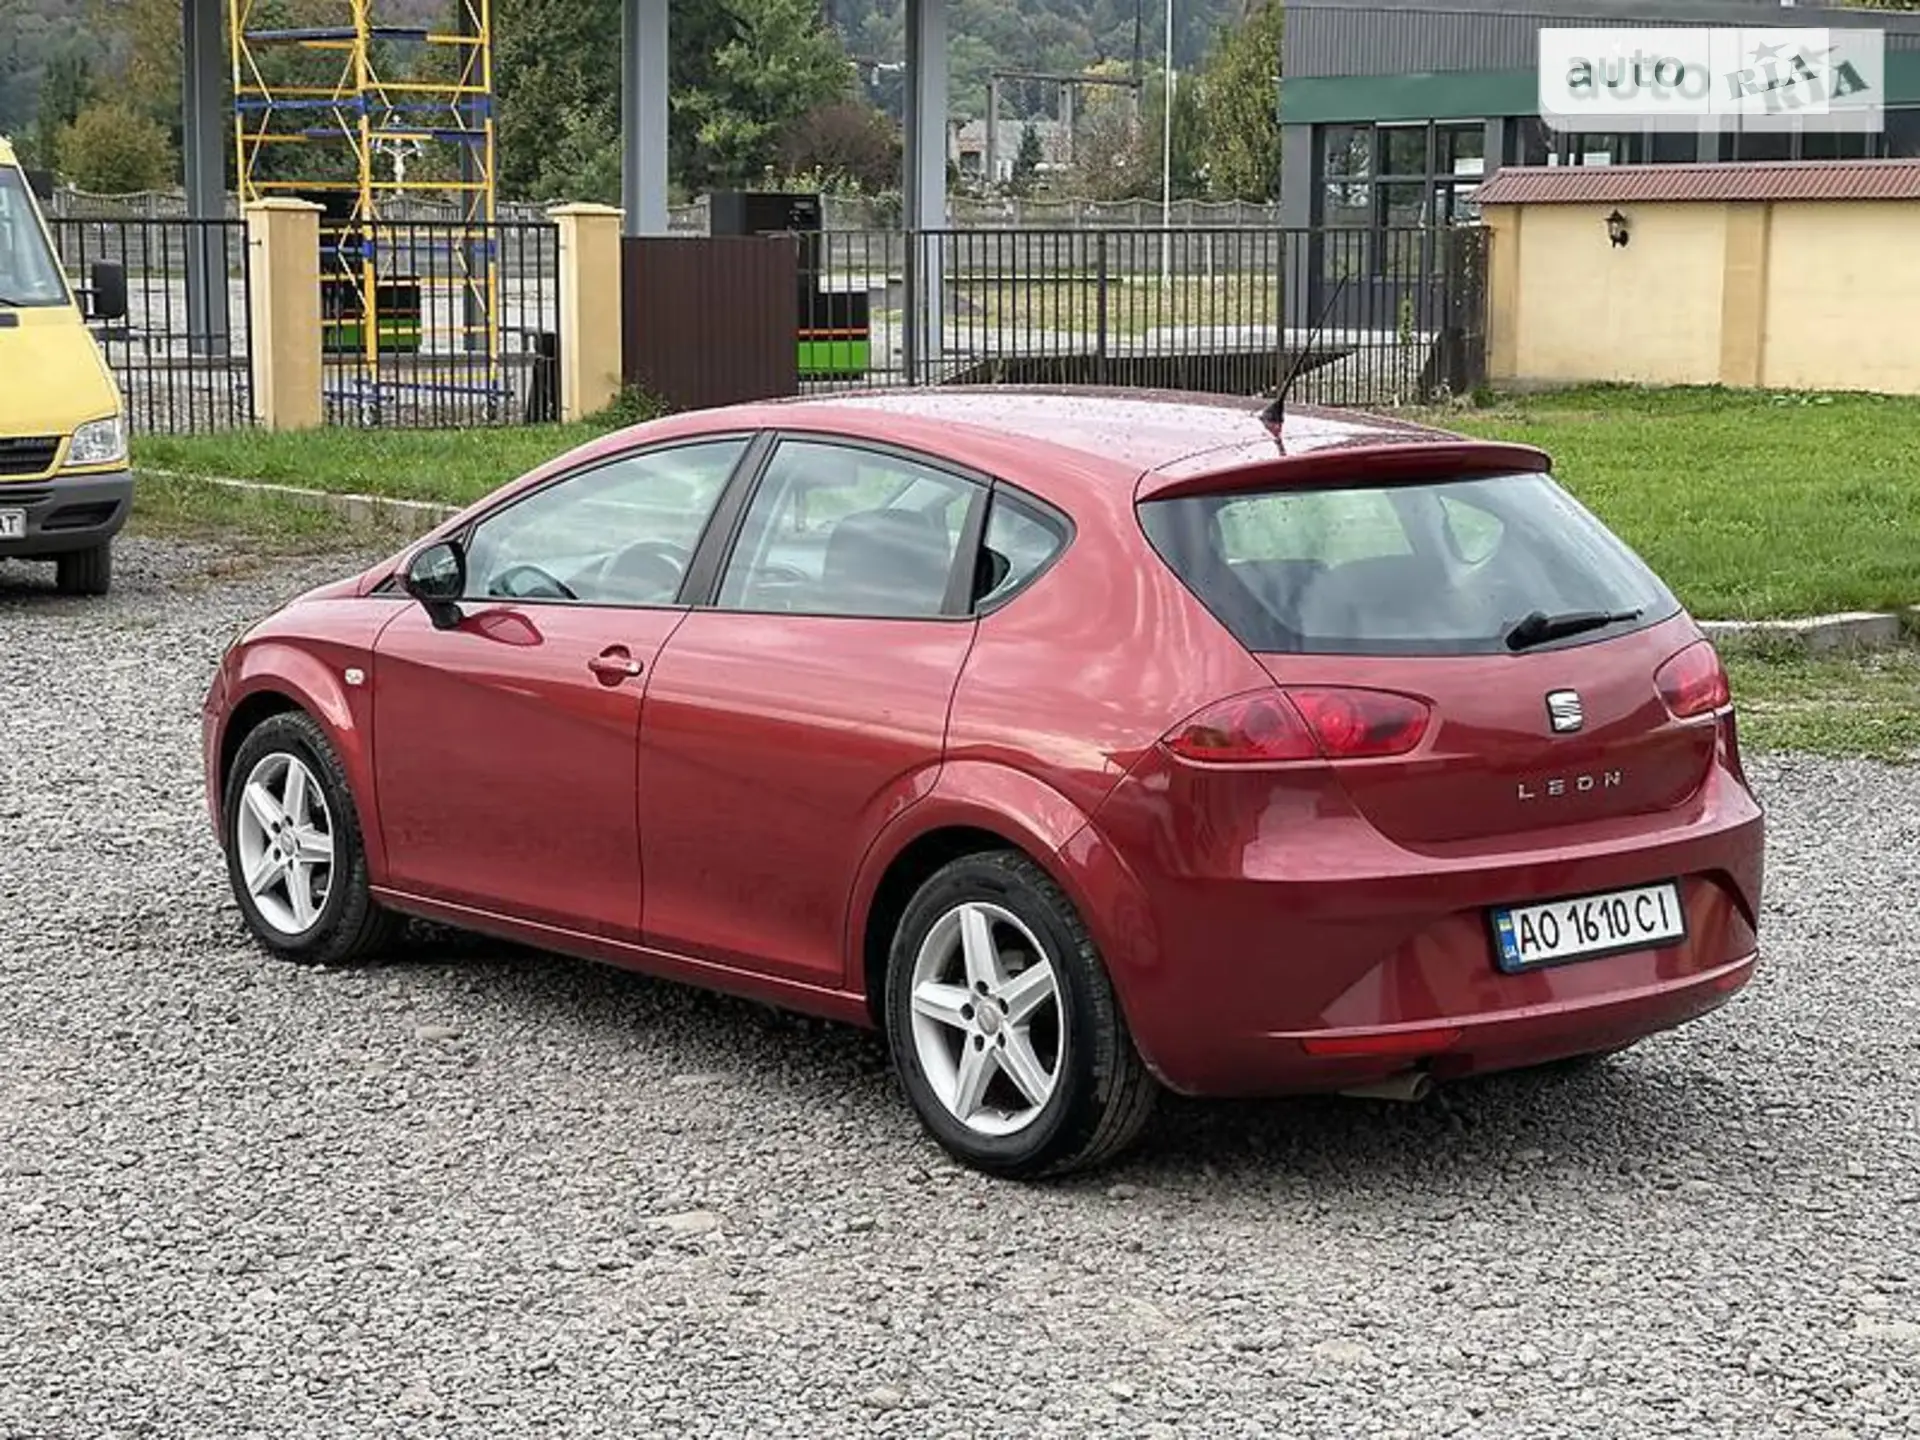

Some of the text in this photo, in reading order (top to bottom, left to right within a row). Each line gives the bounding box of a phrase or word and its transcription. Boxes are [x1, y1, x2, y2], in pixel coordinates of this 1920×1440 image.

[1518, 770, 1622, 799] LEON
[1520, 891, 1670, 954] AO 1610 CI
